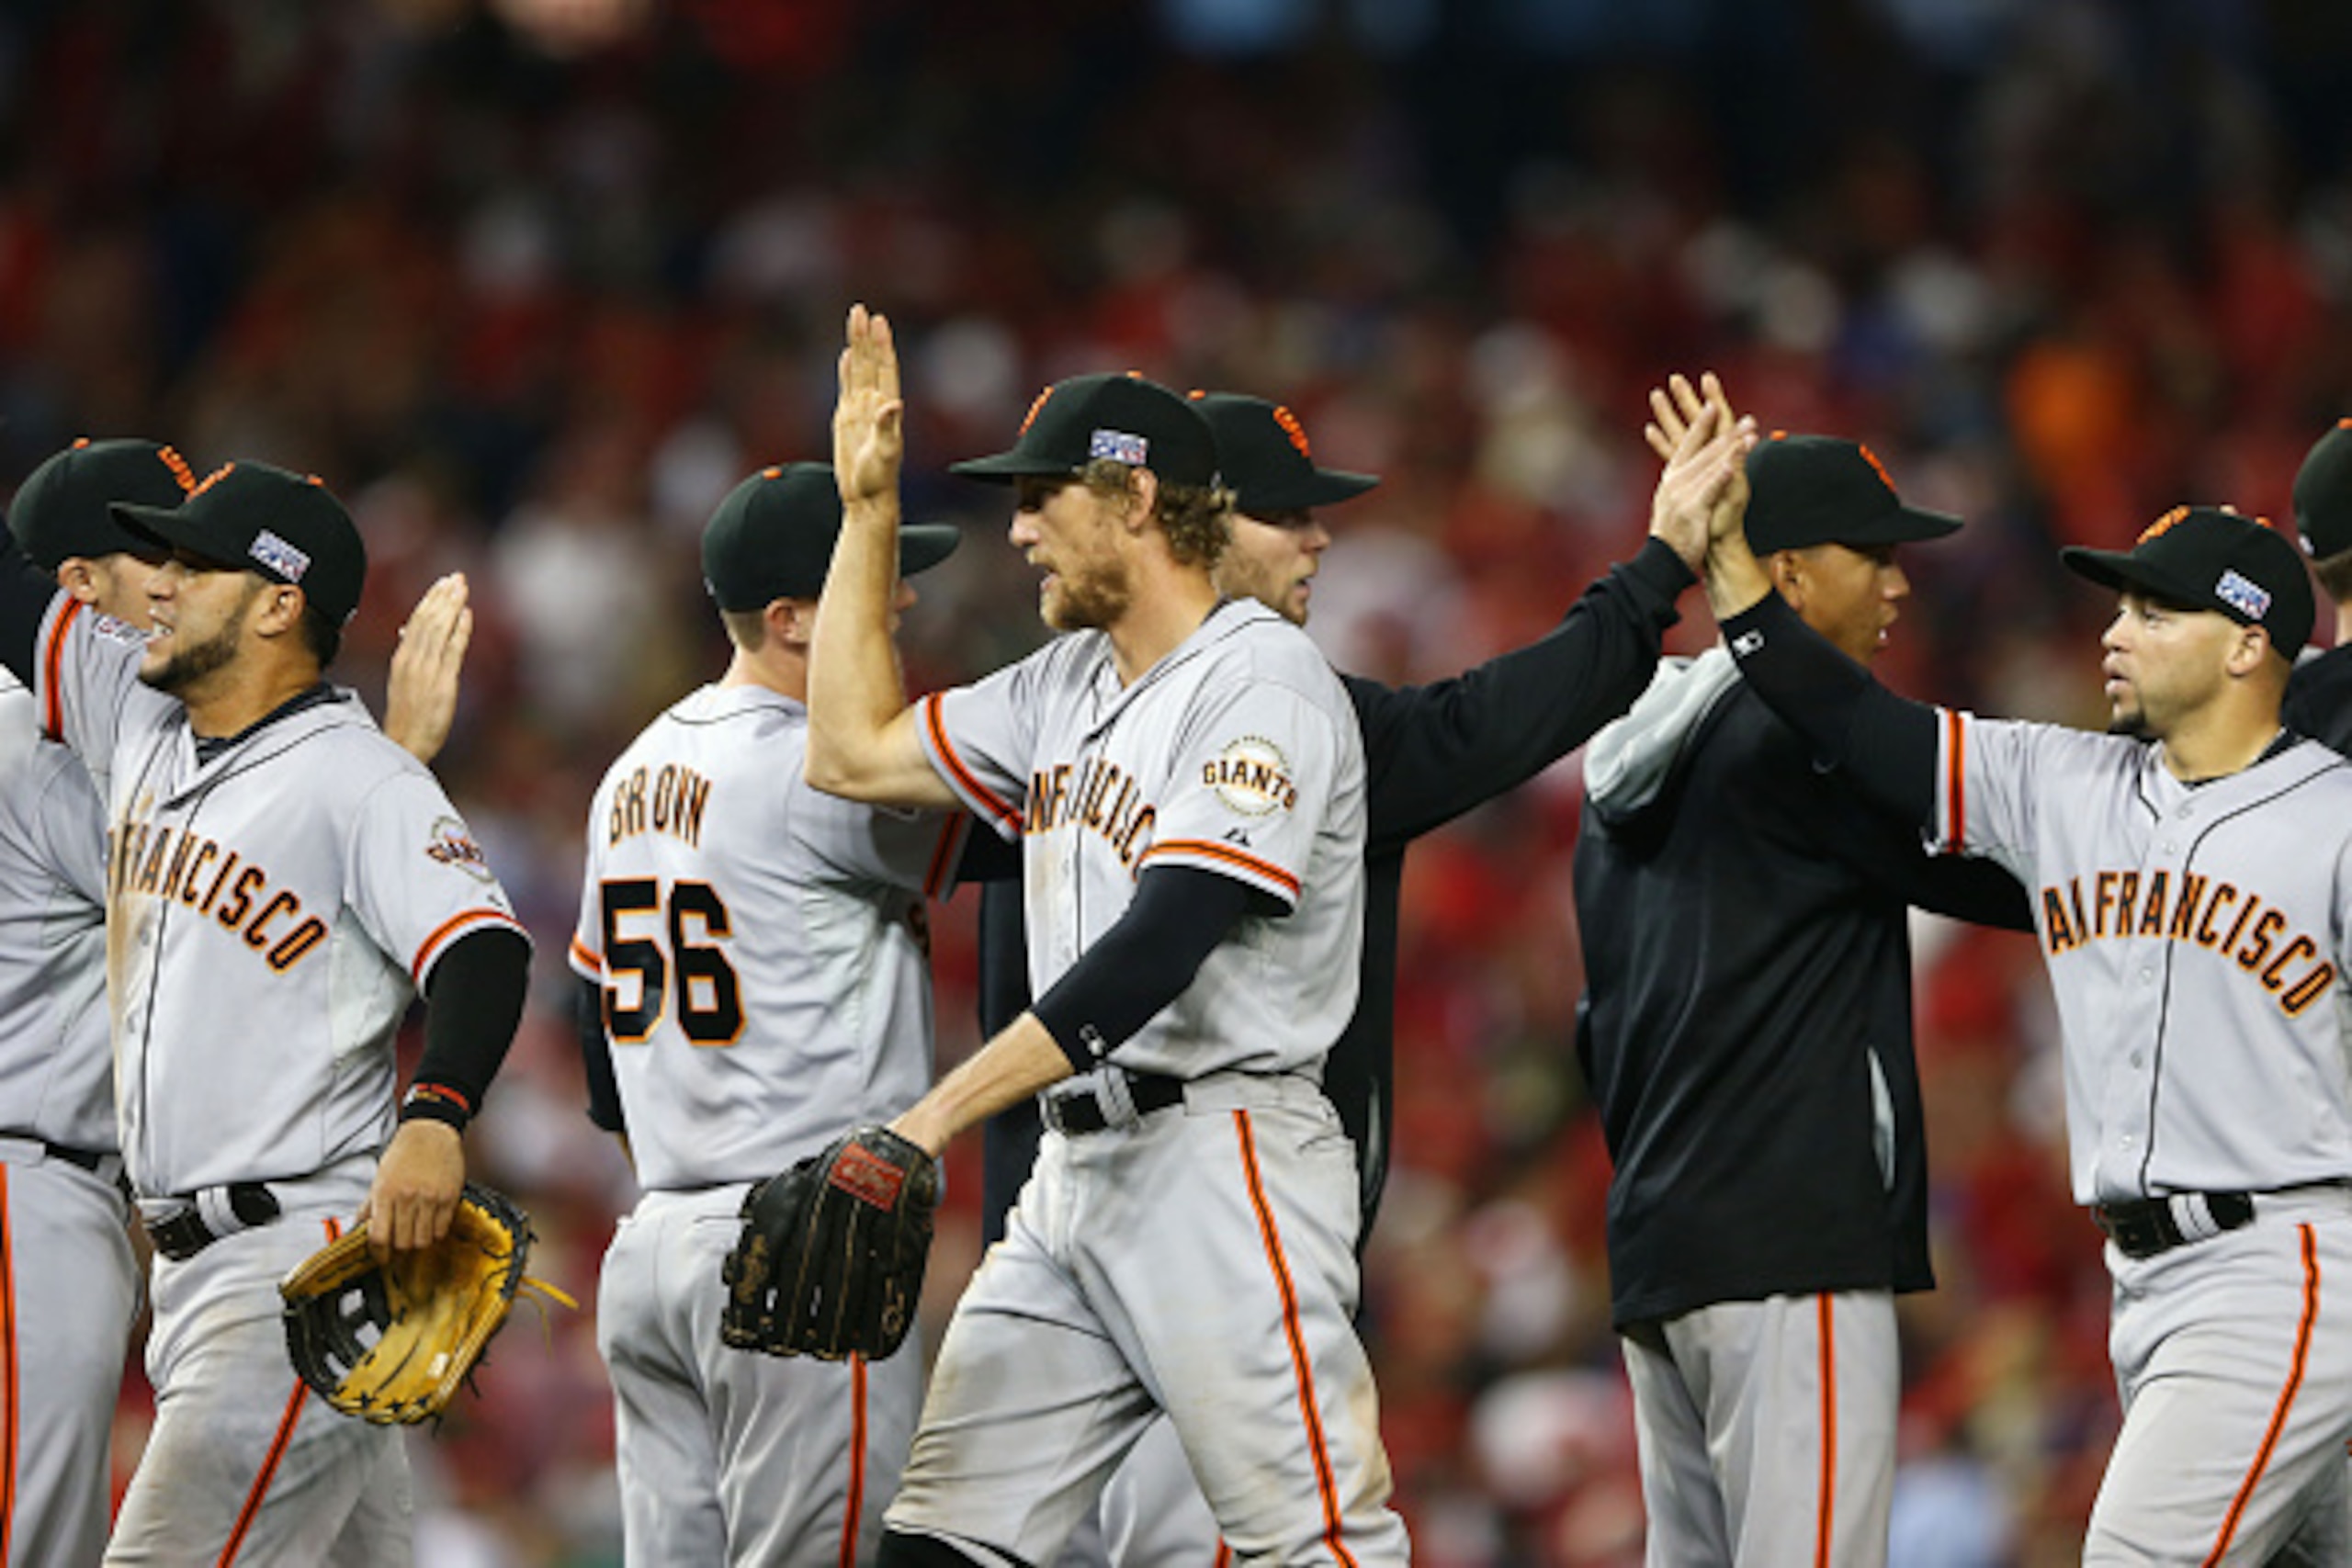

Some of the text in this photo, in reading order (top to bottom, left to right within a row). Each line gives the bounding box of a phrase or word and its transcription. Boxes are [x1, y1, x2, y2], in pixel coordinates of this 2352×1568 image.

[1203, 760, 1298, 811] GIANTS
[598, 875, 747, 1046] 56
[2094, 869, 2336, 1019] FRANCISCO
